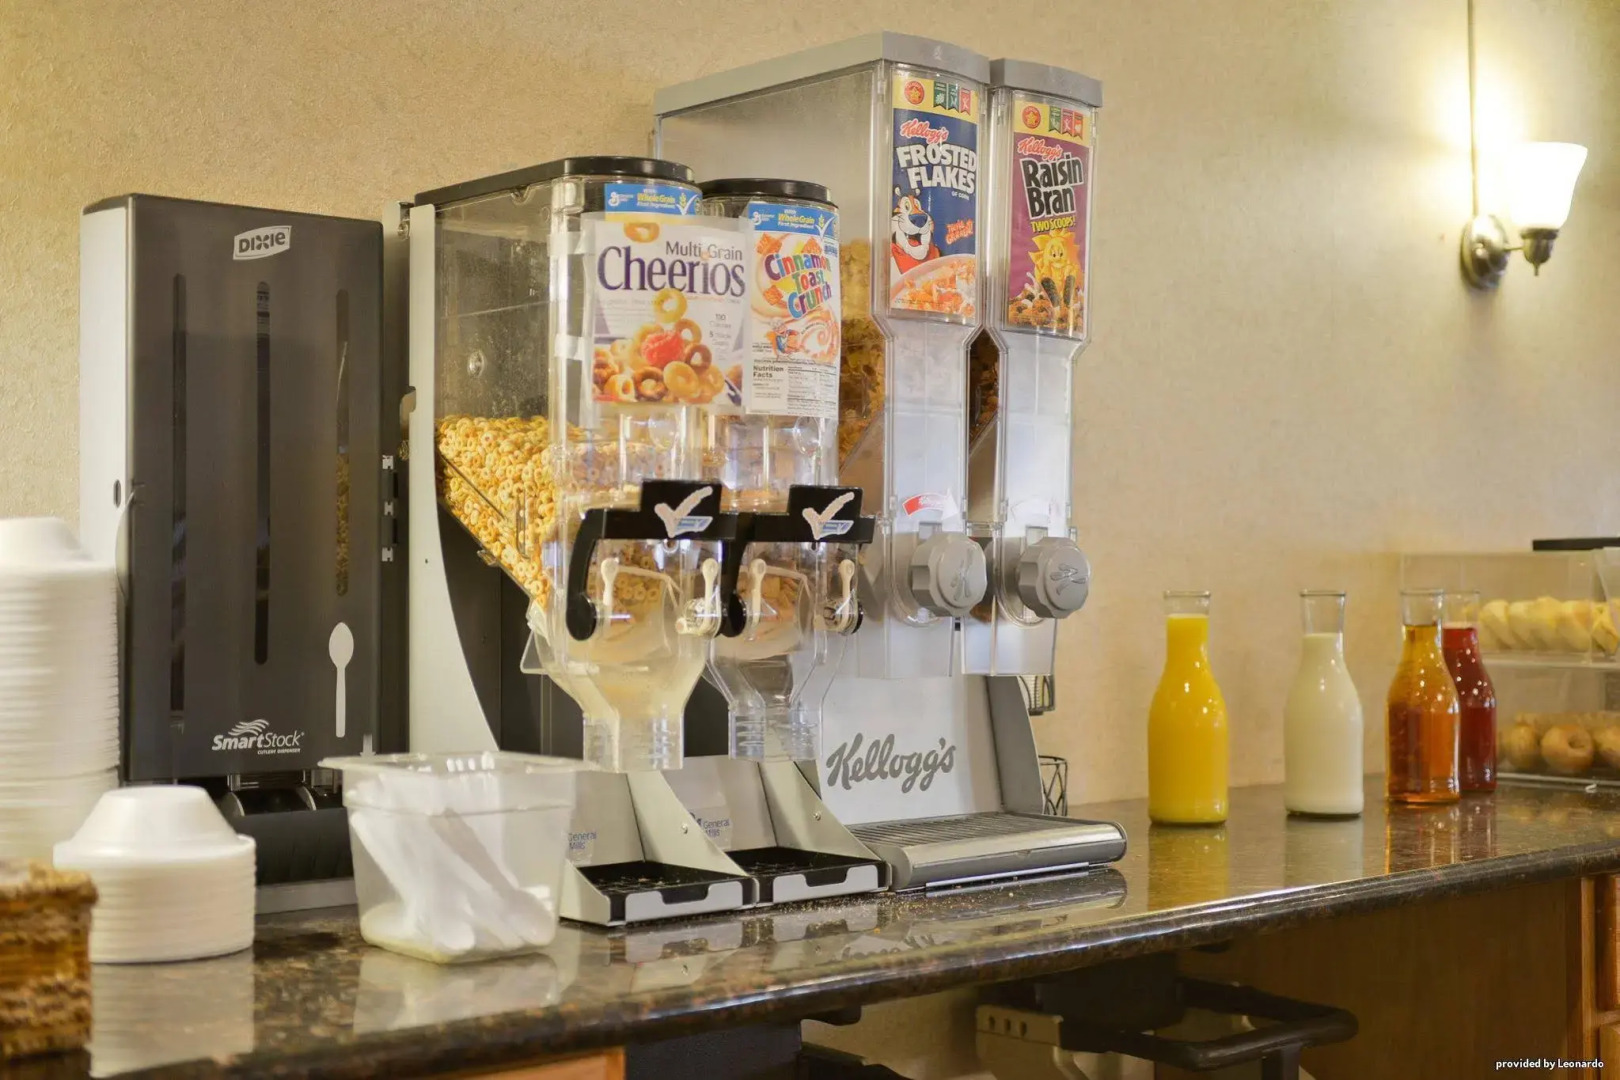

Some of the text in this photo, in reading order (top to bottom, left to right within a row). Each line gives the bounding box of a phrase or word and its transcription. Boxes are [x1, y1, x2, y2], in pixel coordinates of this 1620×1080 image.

[900, 118, 949, 144] Kellogg's
[896, 143, 977, 173] FROSTED
[1018, 136, 1063, 161] Kellogg's
[907, 166, 976, 194] FLAKES
[1020, 152, 1084, 188] Raisin
[1026, 187, 1076, 220] Bran
[1031, 216, 1076, 232] TWO SCOOPS!
[666, 241, 742, 260] Multi Grain
[597, 245, 746, 297] Cheerios
[765, 253, 831, 281] Cinnamon
[792, 269, 825, 294] Toast
[788, 282, 832, 319] Crunch
[826, 732, 956, 794] Kellogg's
[703, 818, 730, 829] General
